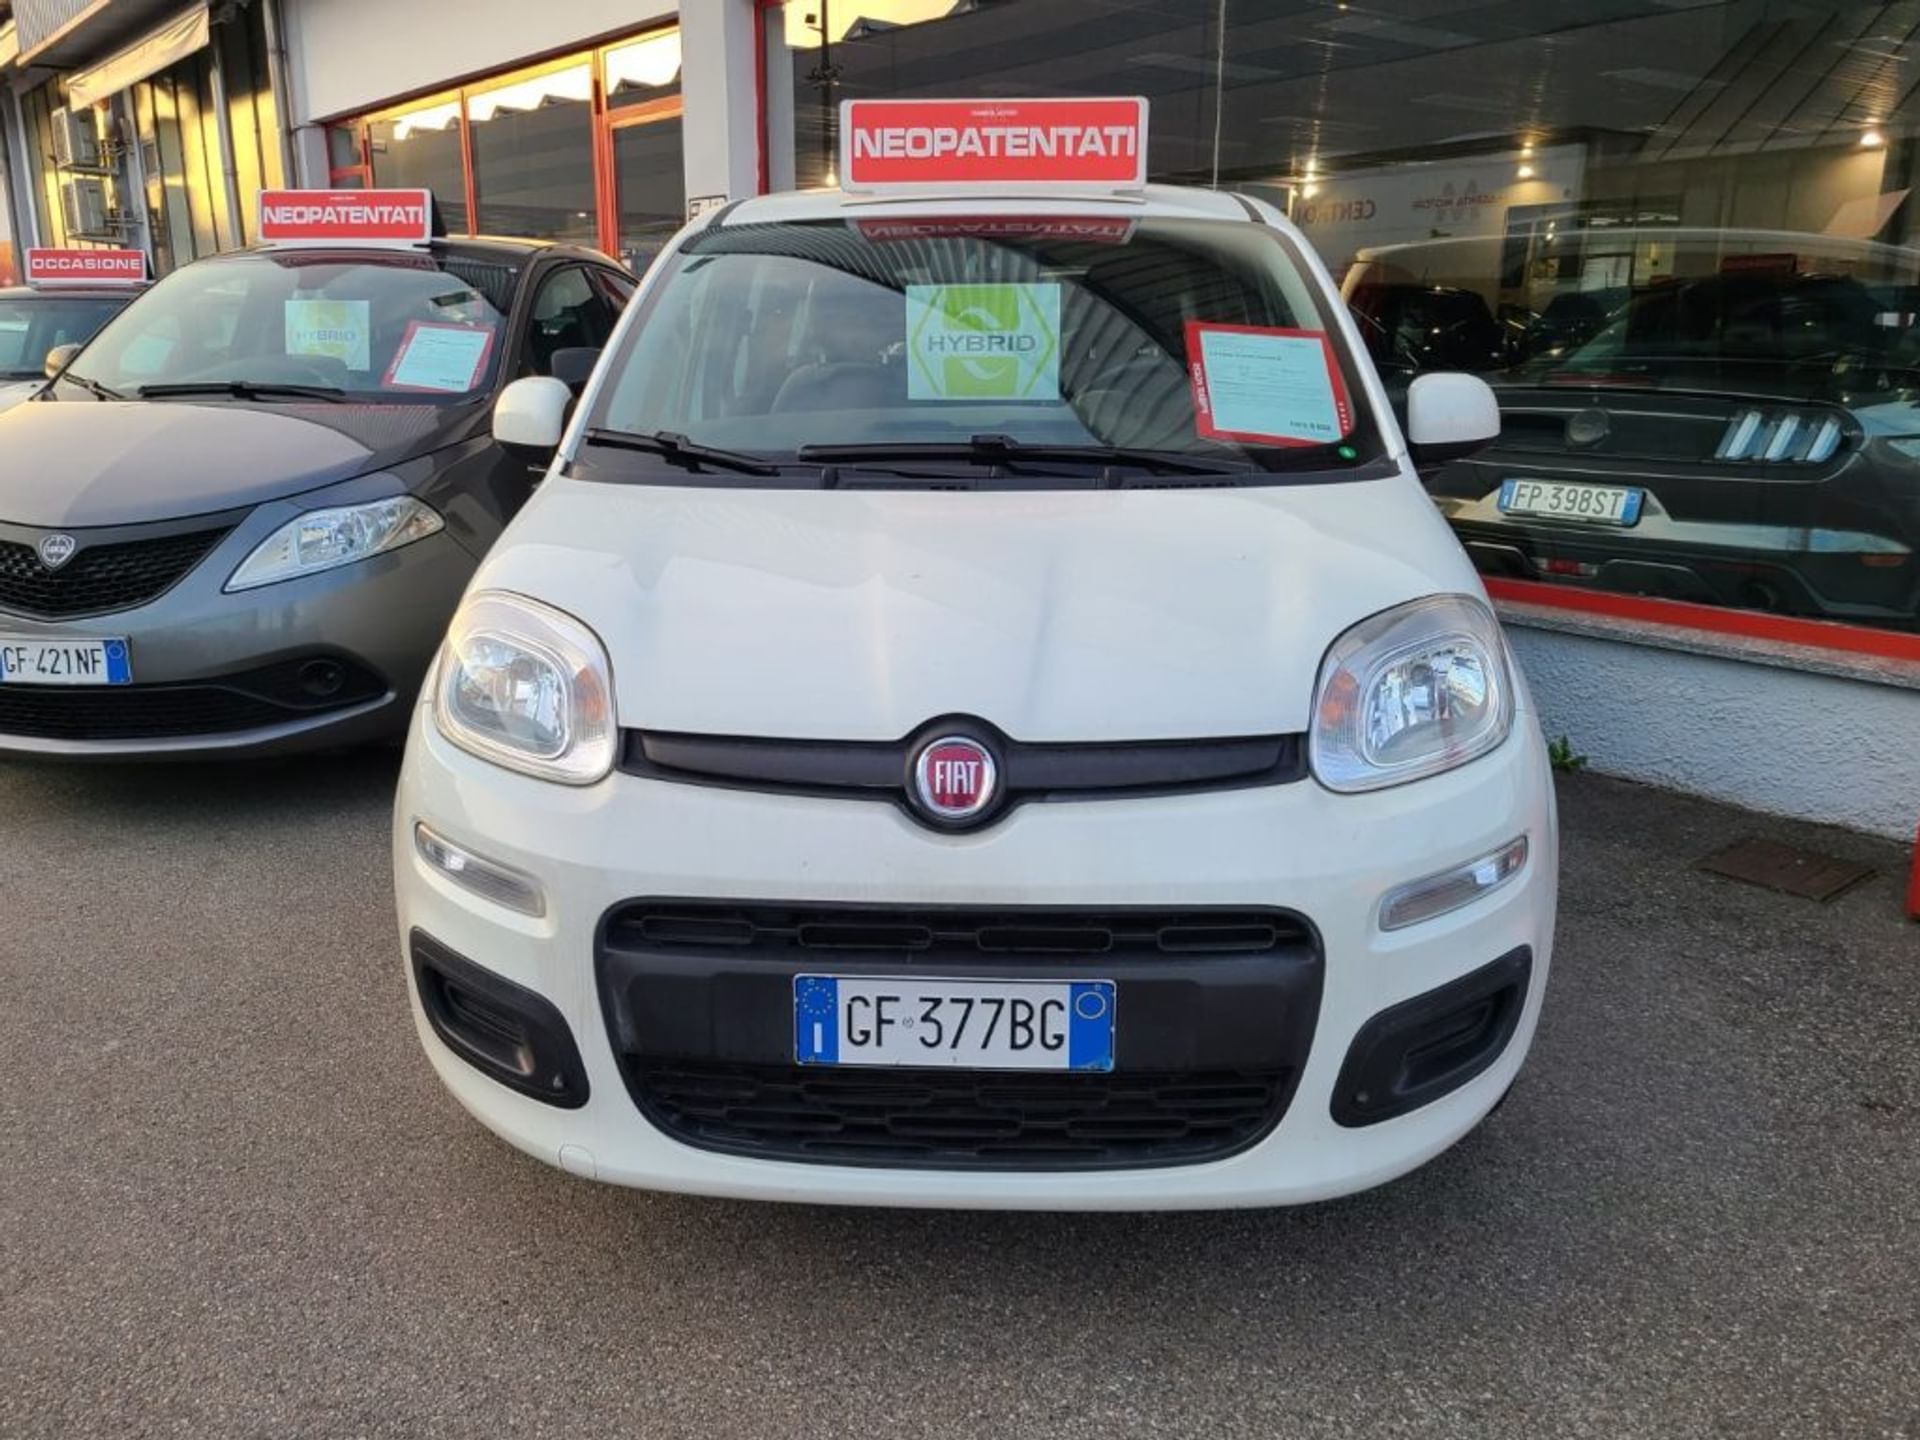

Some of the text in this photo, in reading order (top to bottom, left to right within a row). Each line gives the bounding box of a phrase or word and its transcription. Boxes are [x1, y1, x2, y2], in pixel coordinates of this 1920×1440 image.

[855, 126, 1136, 159] NEOPATENTATI
[262, 206, 424, 226] NEOPATENTATI
[31, 257, 141, 271] OCCASIONE
[296, 328, 357, 342] HYBRID
[927, 334, 1037, 353] HYBRID
[1513, 483, 1543, 509] FP
[1549, 486, 1624, 516] 398ST
[3, 646, 103, 675] GF 421NF
[934, 760, 981, 795] FIAT
[846, 995, 901, 1048] GF
[918, 997, 1066, 1051] 377BG
